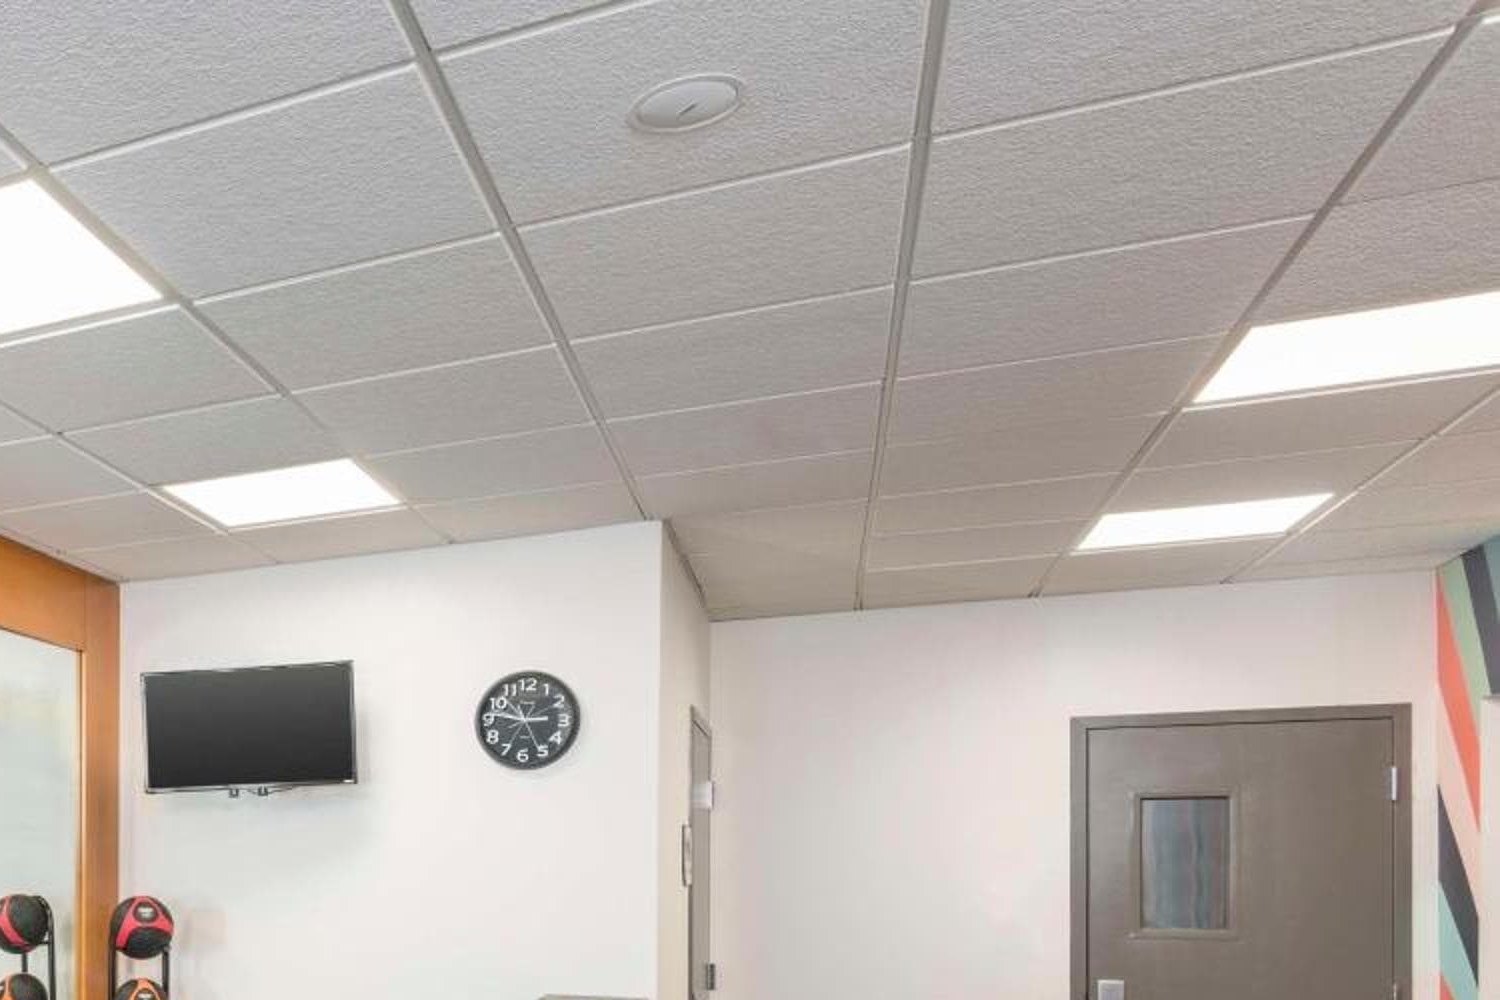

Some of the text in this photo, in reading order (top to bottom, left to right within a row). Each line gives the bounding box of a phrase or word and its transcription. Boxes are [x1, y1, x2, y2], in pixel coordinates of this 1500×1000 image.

[503, 684, 517, 696] 11
[519, 678, 537, 691] 12
[543, 683, 549, 696] 1
[490, 697, 507, 710] 10
[553, 694, 565, 708] 2
[483, 713, 495, 727] 9
[557, 713, 570, 727] 3
[486, 729, 499, 744] 8
[549, 731, 562, 745] 4
[501, 743, 512, 756] 7
[516, 748, 529, 762] 6
[537, 745, 548, 757] 5
